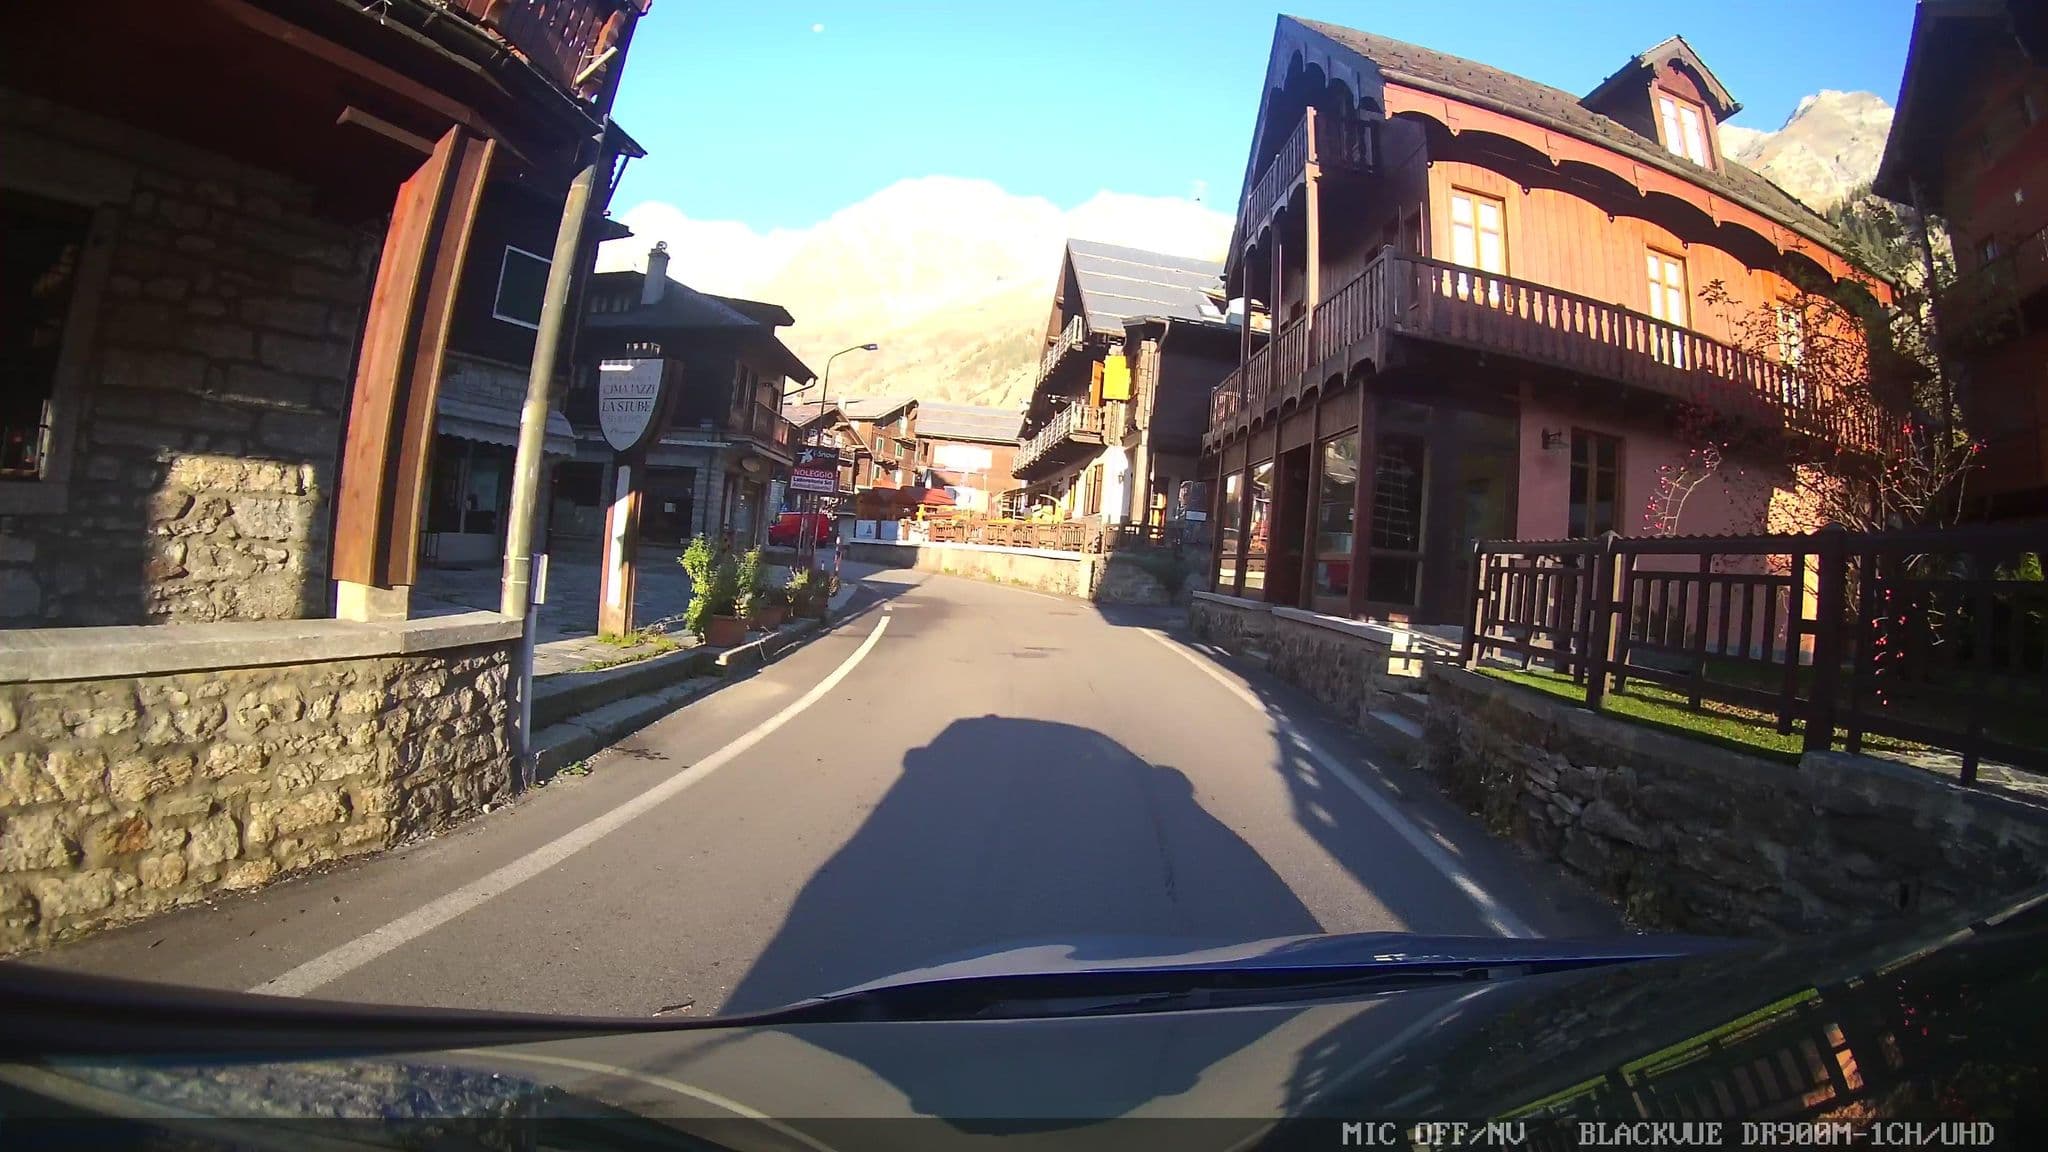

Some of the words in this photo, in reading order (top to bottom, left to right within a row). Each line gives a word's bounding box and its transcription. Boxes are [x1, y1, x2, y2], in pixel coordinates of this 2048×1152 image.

[602, 401, 615, 412] LA
[617, 401, 652, 412] STUBE
[794, 469, 833, 479] NOLEGGIO
